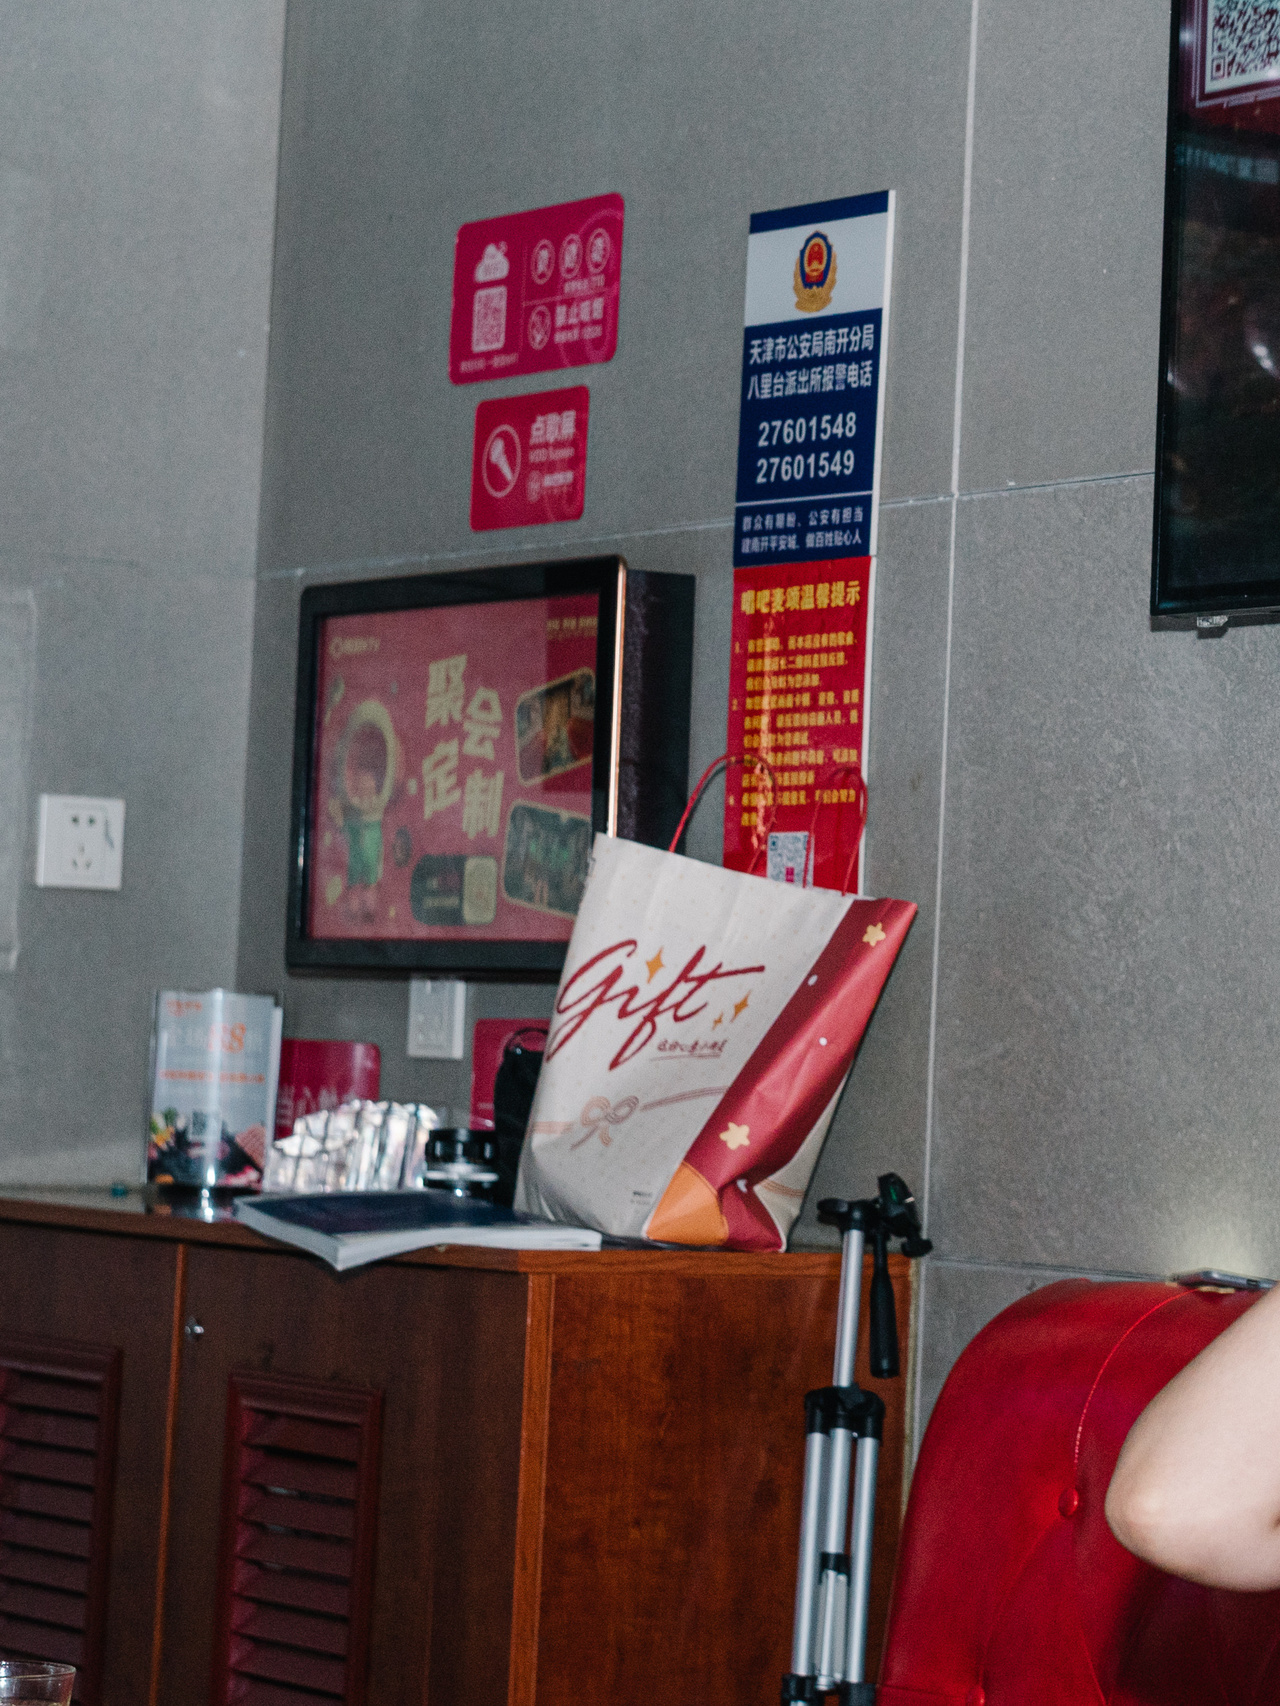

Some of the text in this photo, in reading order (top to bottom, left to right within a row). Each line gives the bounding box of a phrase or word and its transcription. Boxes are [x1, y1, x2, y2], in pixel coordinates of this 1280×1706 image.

[749, 323, 875, 366] 天津市公安局南开分局
[746, 360, 874, 400] 八里台派出所报警电话
[757, 411, 857, 448] 27601548
[755, 449, 855, 485] 27601549
